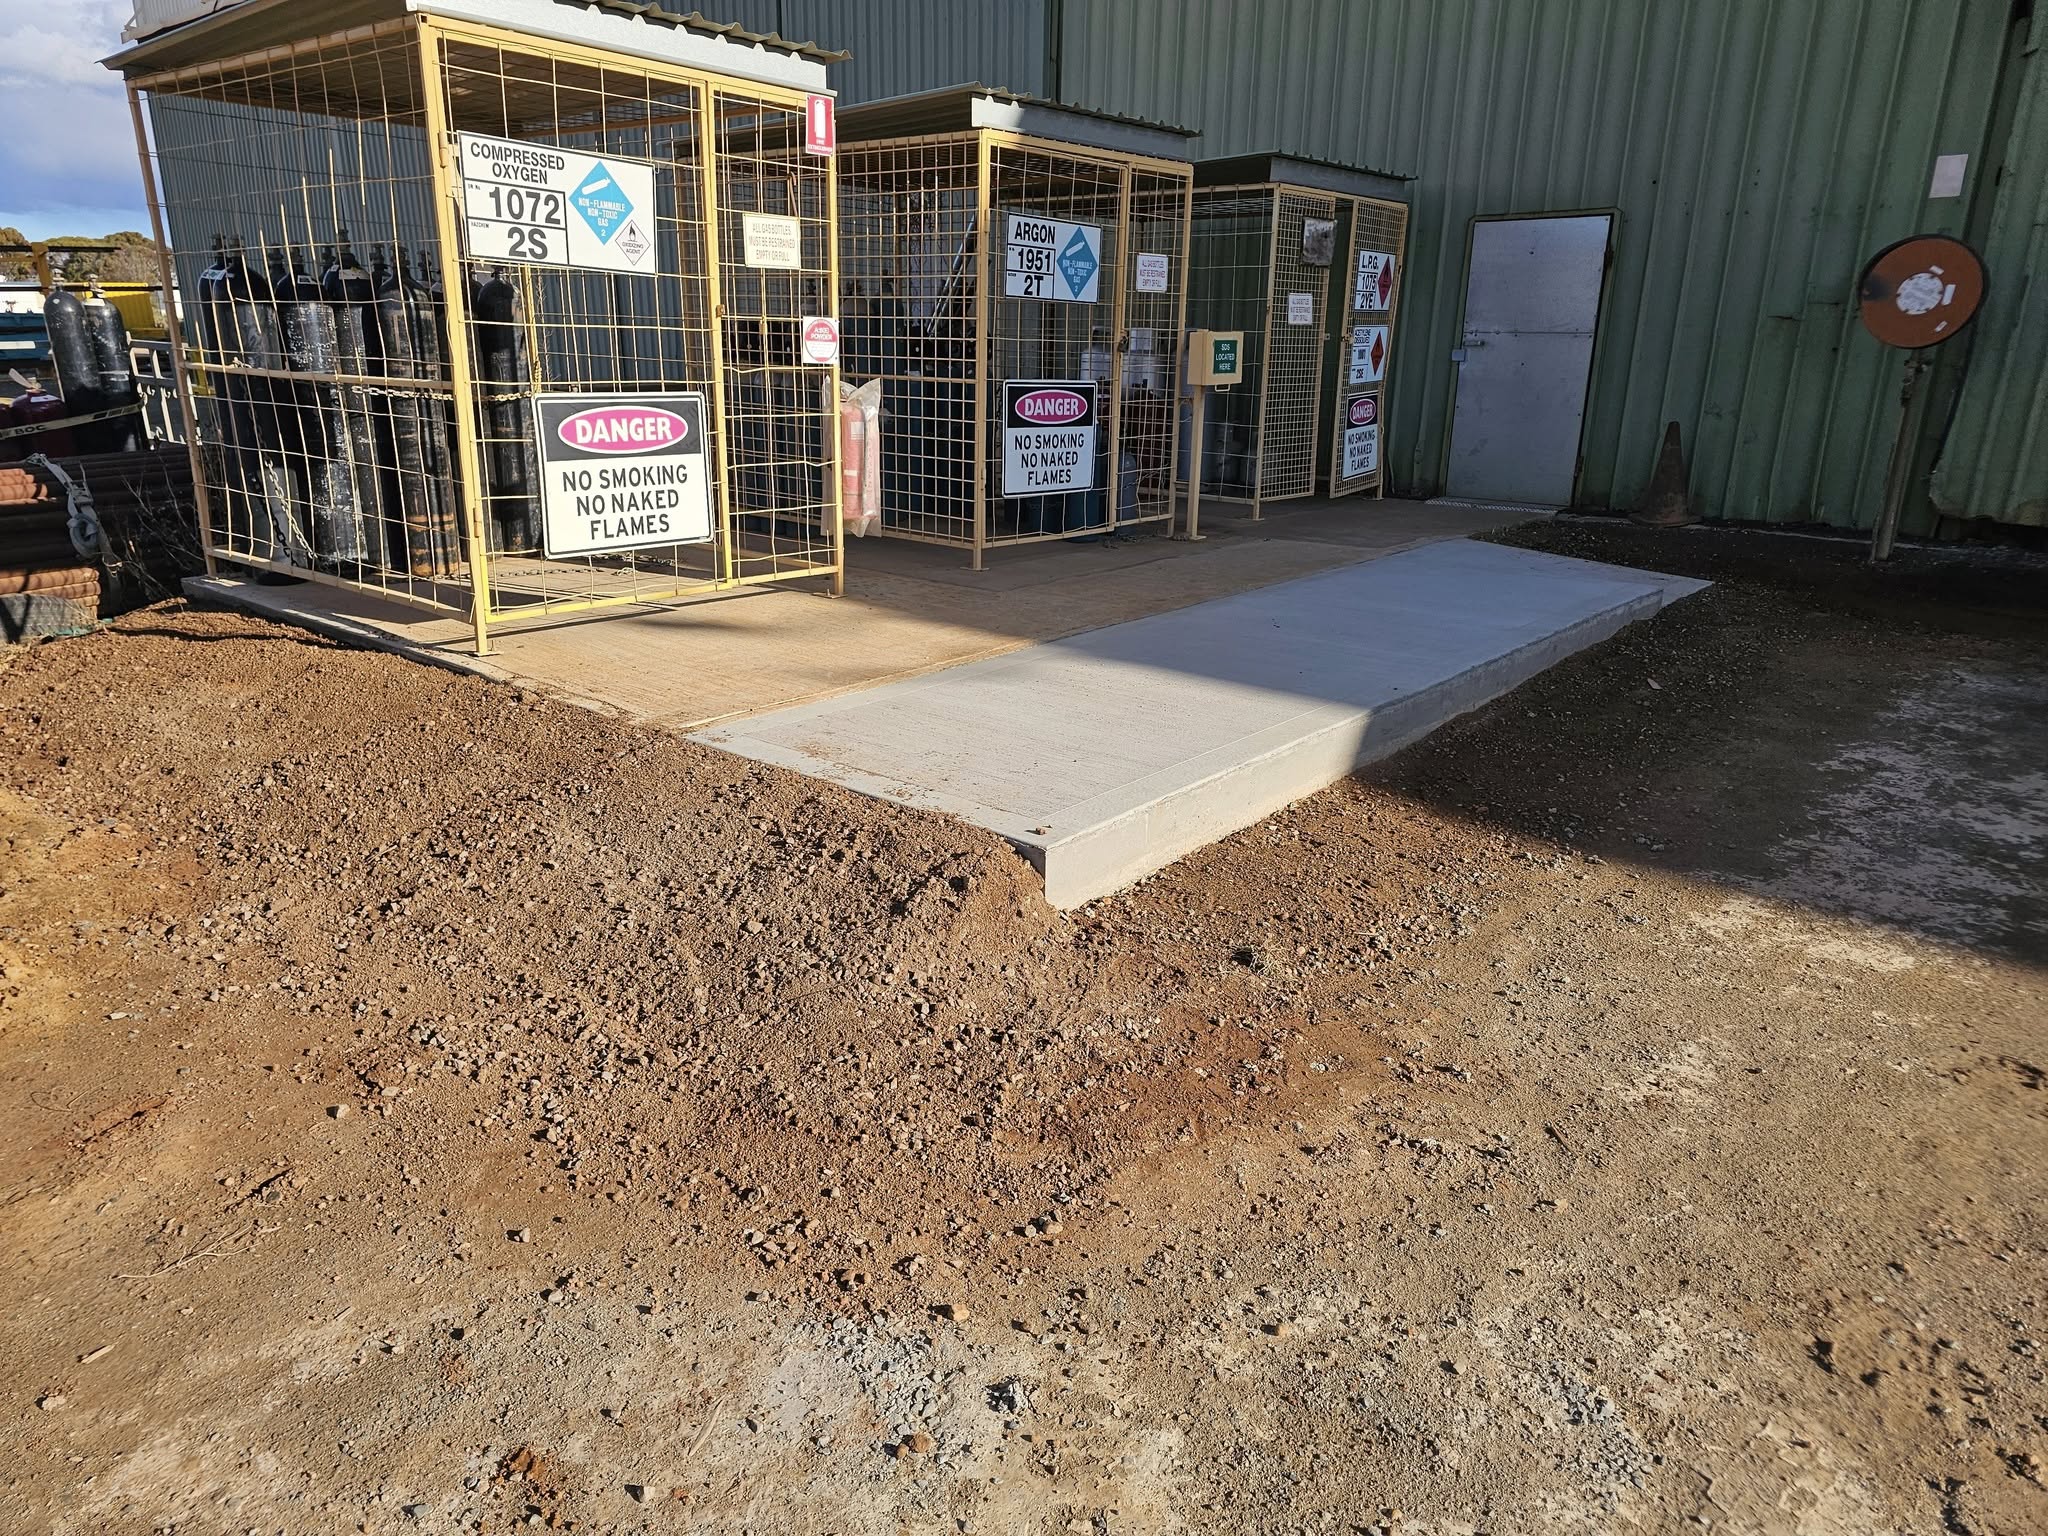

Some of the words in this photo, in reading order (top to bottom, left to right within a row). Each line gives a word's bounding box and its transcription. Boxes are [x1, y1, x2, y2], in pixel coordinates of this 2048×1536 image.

[471, 142, 565, 171] COMPRESSED
[492, 162, 548, 185] OXYGEN
[489, 186, 561, 225] 1072
[598, 217, 609, 227] GAS
[601, 229, 606, 237] 2
[1014, 221, 1056, 244] ARGON
[507, 226, 549, 260] 2S
[1018, 248, 1051, 273] 1951
[1362, 254, 1379, 270] L.P.G.
[1023, 274, 1044, 297] 2T
[1362, 274, 1377, 291] 1075
[1360, 292, 1374, 309] 2YE
[1221, 343, 1231, 351] SDS
[1219, 362, 1231, 370] HERE
[1024, 398, 1079, 416] DANGER
[1352, 404, 1373, 420] DANGER
[15, 425, 47, 434] BOC
[575, 417, 673, 444] DANGER
[1348, 433, 1355, 445] NO
[1355, 429, 1376, 444] SMOKING
[1014, 434, 1031, 450] NO
[1035, 433, 1085, 450] SMOKING
[1349, 446, 1356, 458] NO
[1357, 443, 1373, 457] NAKED
[1021, 453, 1038, 468] NO
[1041, 451, 1079, 467] NAKED
[1351, 456, 1370, 471] FLAMES
[562, 470, 592, 492] NO
[599, 464, 688, 490] SMOKING
[1027, 469, 1072, 486] FLAMES
[576, 494, 605, 517] NO
[611, 489, 679, 514] NAKED
[590, 513, 670, 540] FLAMES
